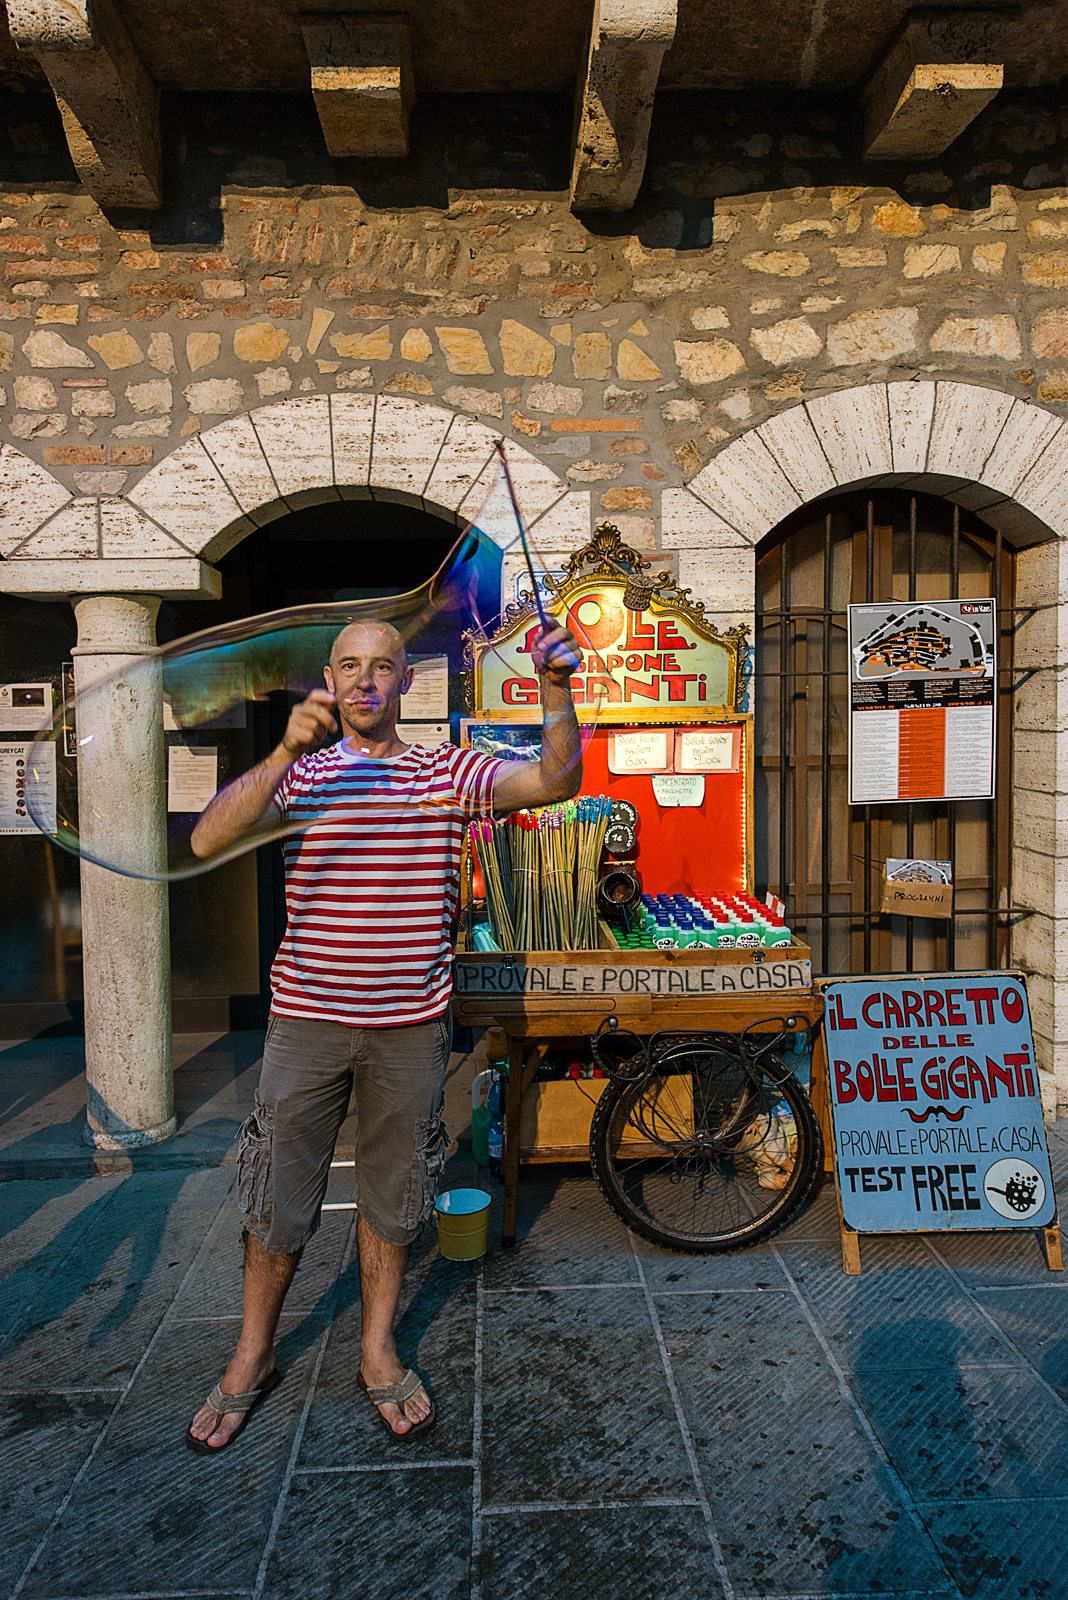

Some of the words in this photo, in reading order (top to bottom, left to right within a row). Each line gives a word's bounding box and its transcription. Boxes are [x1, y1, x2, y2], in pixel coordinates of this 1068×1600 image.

[516, 593, 697, 654] OLLE
[502, 673, 708, 705] GGANTi
[655, 777, 697, 787] CONCENTRATO
[463, 966, 577, 992] PROVALE
[583, 976, 595, 992] E
[602, 968, 715, 993] PORTALE
[722, 975, 736, 991] A
[741, 964, 805, 990] CASA
[862, 987, 1024, 1029] CARRETTO
[883, 1033, 975, 1050] DELLE
[834, 1053, 918, 1104] BOLLE
[840, 1129, 910, 1156] PROVALE
[919, 1127, 988, 1154] PORTALE
[1000, 1126, 1043, 1152] CASA
[844, 1165, 906, 1193] TEST
[911, 1164, 982, 1212] FREE
